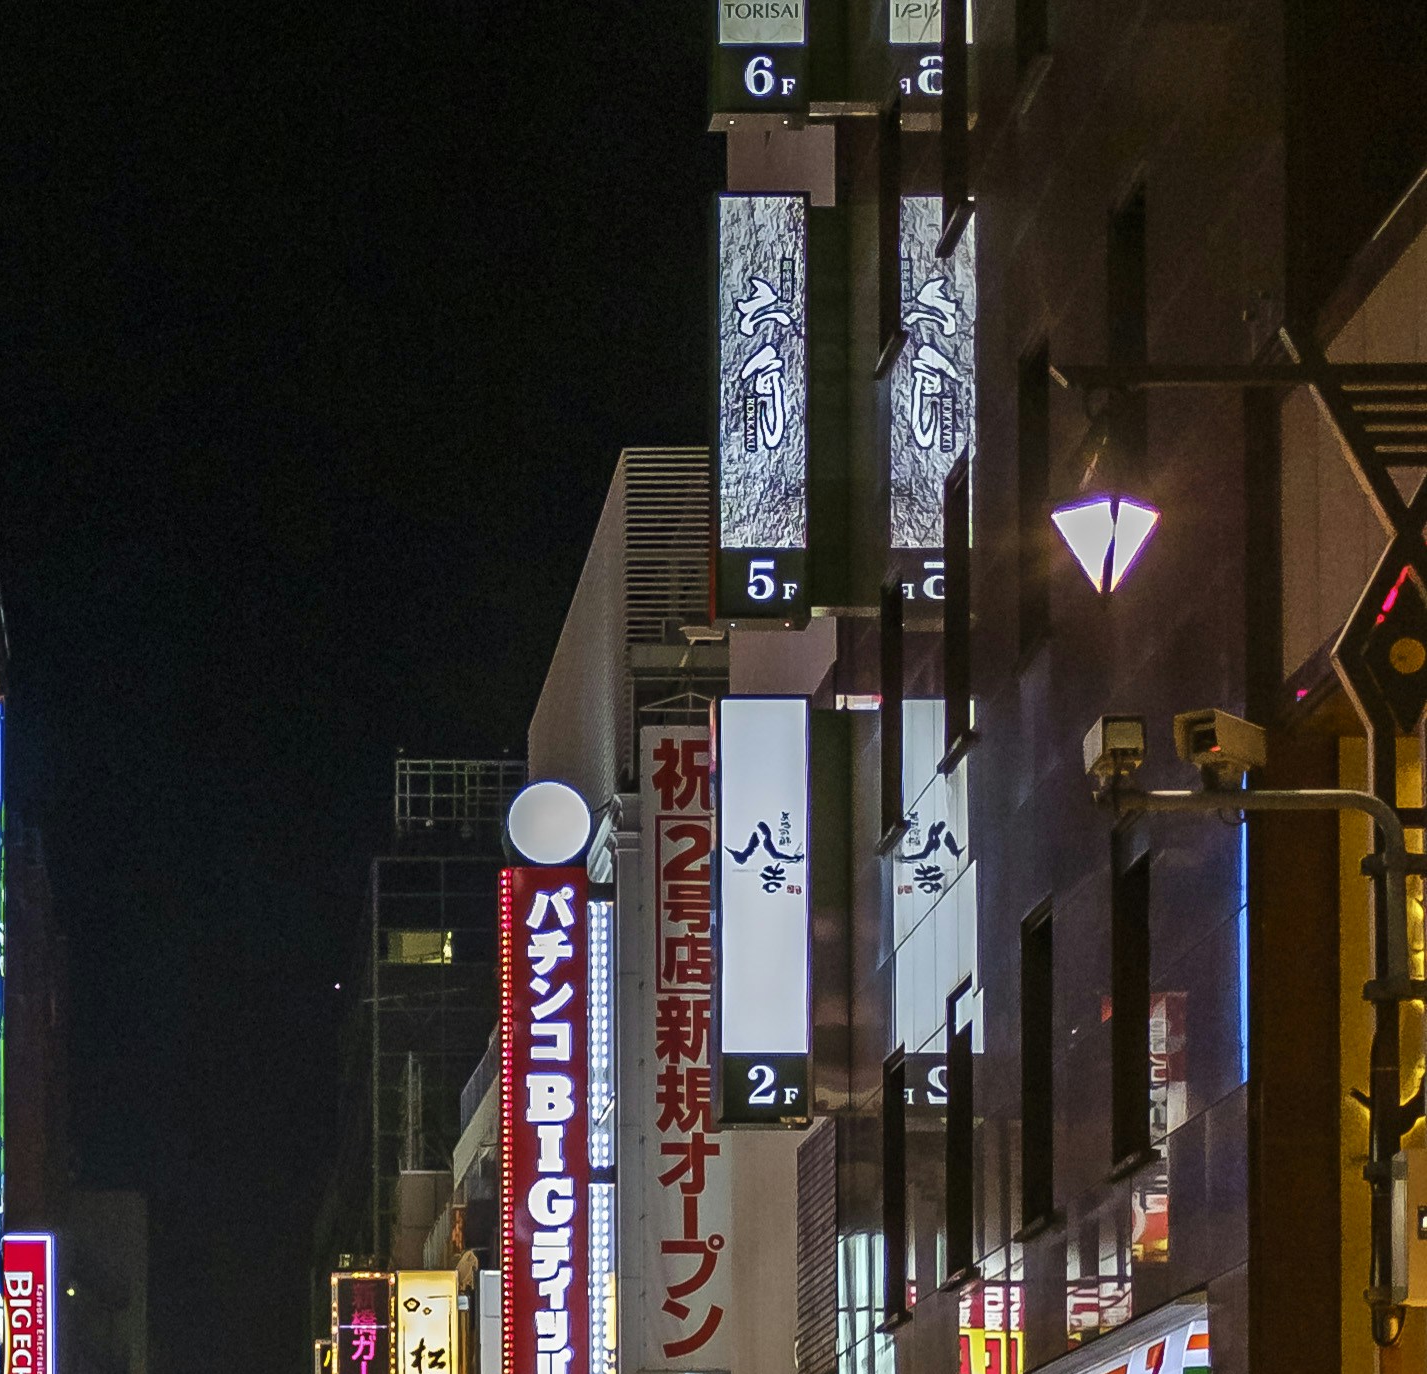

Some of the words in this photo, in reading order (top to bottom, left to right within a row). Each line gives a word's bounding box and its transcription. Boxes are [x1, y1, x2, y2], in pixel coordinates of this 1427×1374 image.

[725, 3, 799, 19] TORISAI
[745, 56, 796, 95] 6F
[747, 561, 797, 600] 5F
[747, 1065, 799, 1105] 2F
[4, 1271, 33, 1329] BIG
